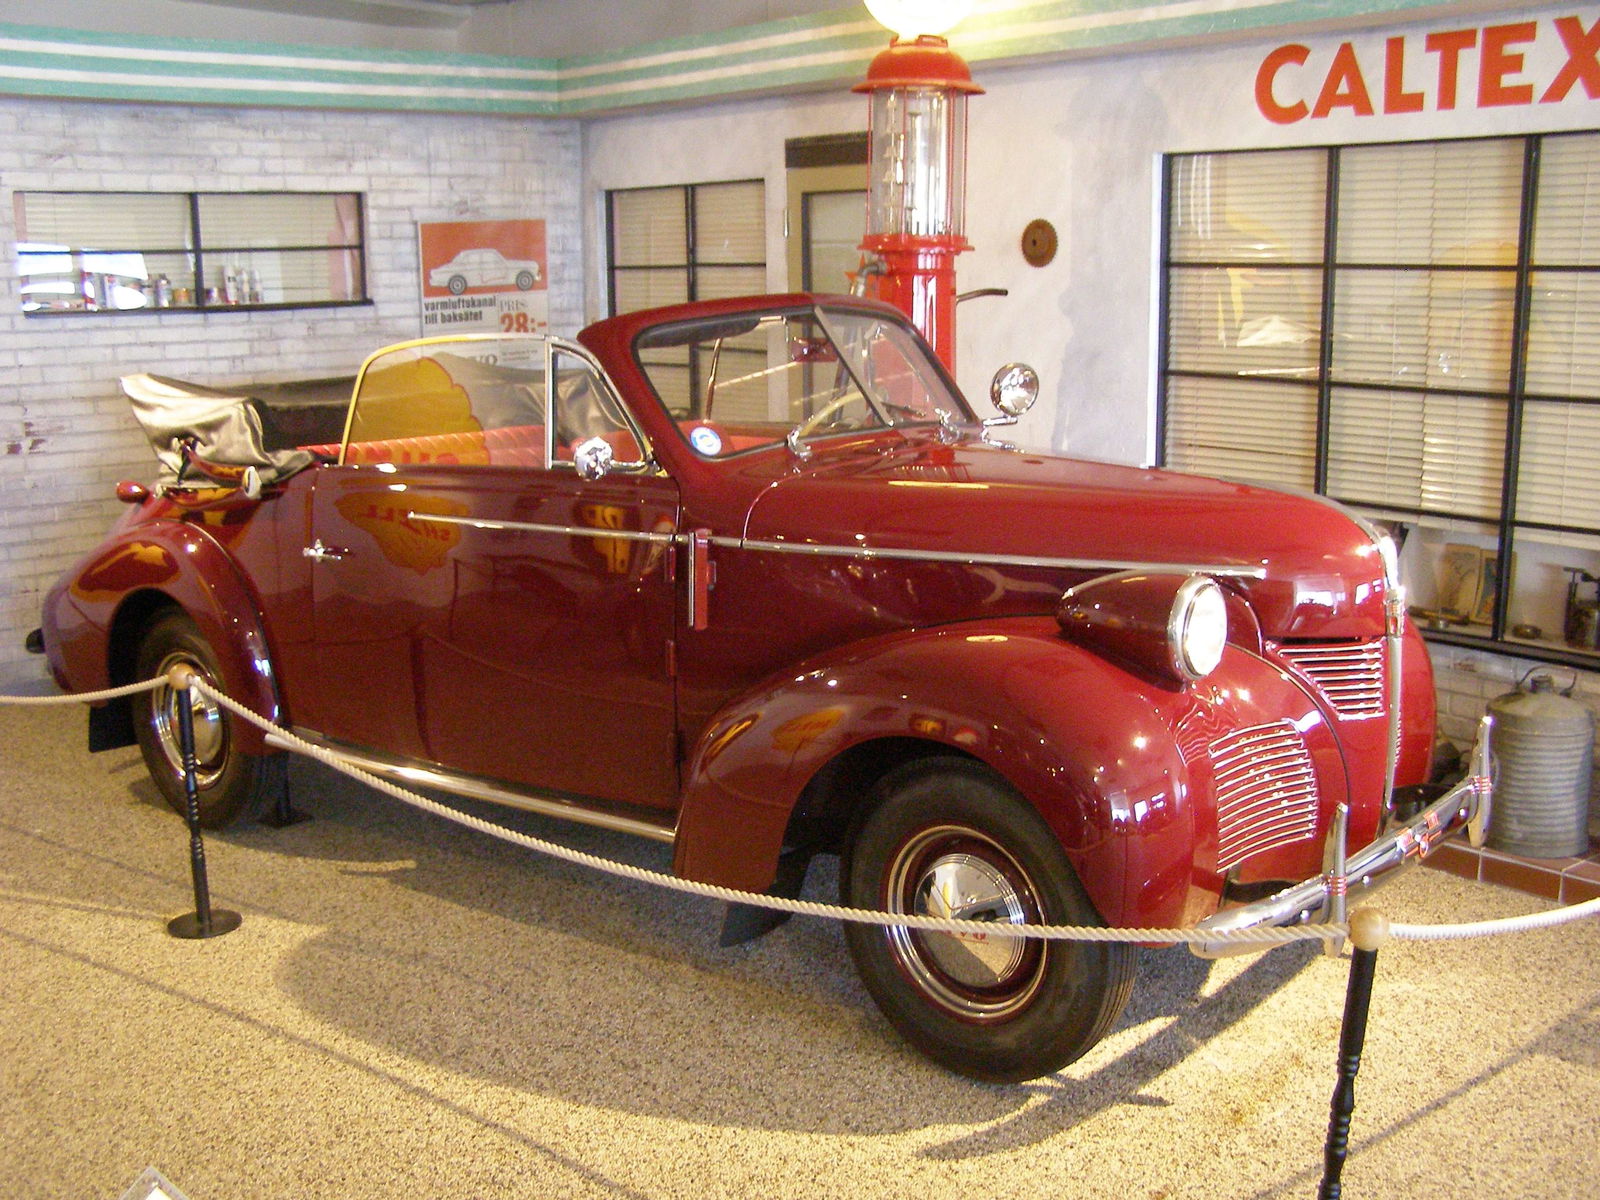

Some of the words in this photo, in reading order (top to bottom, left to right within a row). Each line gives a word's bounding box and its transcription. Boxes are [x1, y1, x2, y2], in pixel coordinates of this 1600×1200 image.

[1254, 16, 1600, 125] CALTEX
[424, 296, 496, 311] varmluftskanal
[425, 312, 438, 325] till
[441, 310, 483, 324] baksätet
